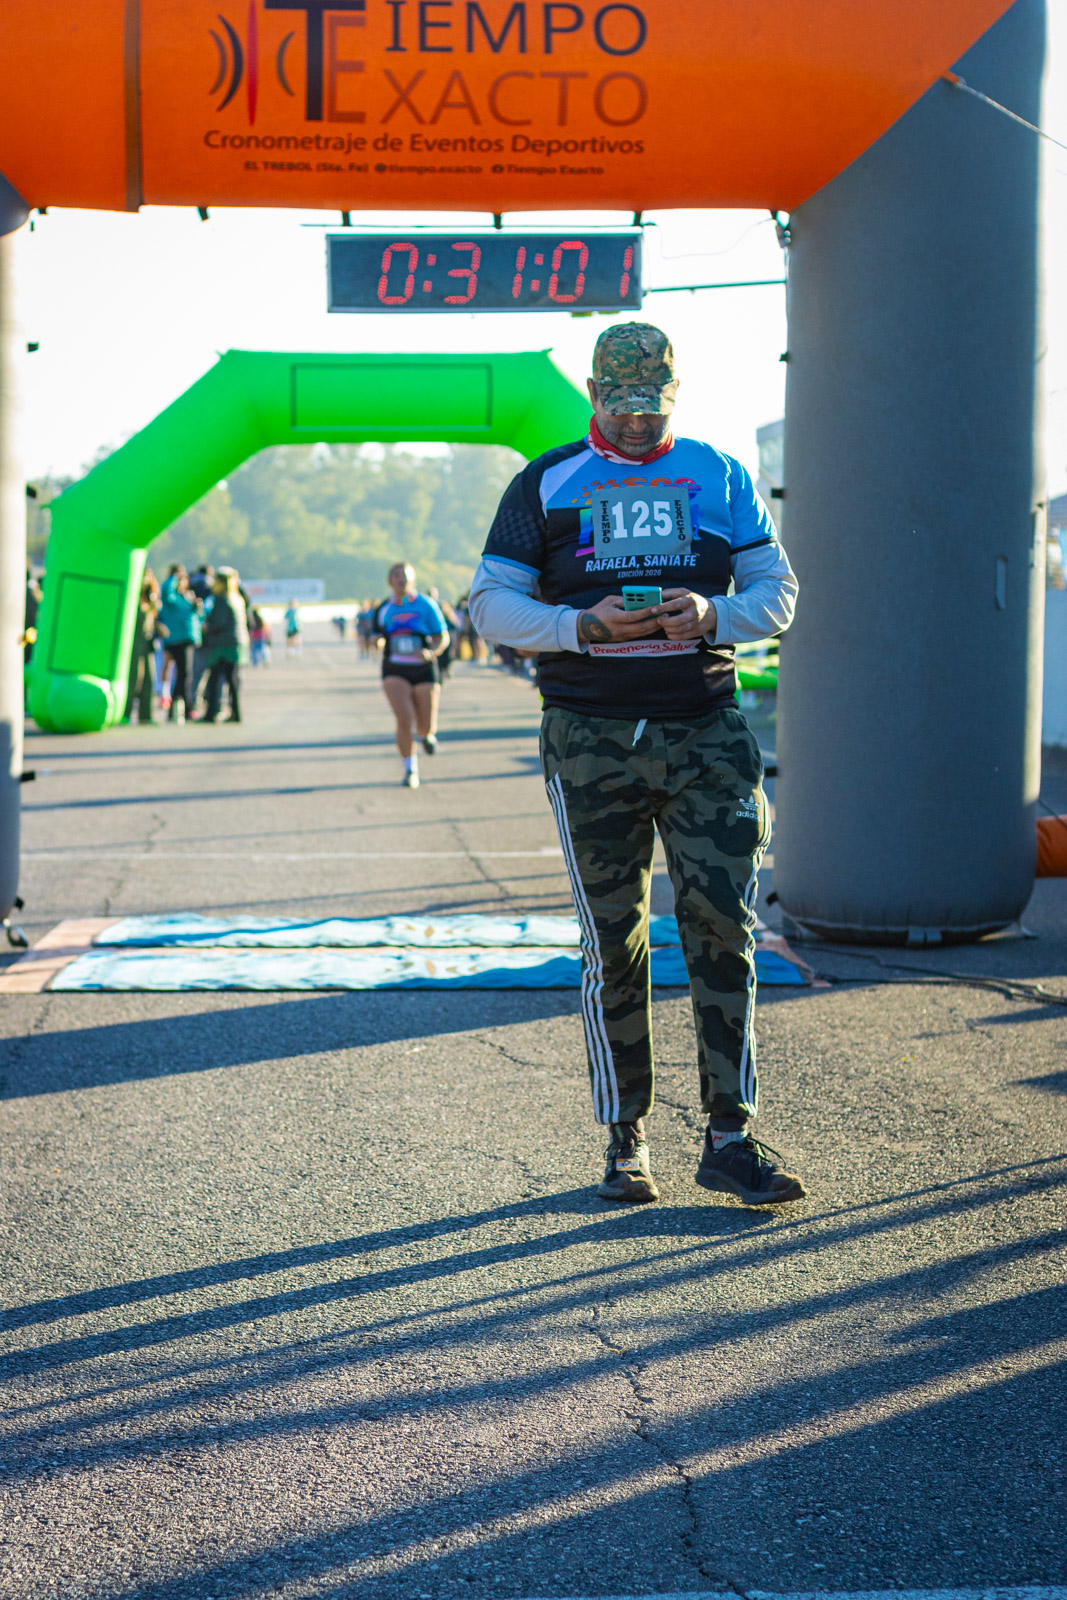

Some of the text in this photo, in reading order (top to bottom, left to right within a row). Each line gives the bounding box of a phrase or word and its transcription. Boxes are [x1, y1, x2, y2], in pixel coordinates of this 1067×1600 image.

[203, 129, 645, 157] Cronometraje de Eventos Deportivos
[600, 500, 611, 544] TIEMPO
[611, 500, 673, 539] 125
[674, 499, 686, 541] EXACTO
[585, 554, 697, 572] RAFAELA, SANTA FE
[644, 568, 662, 577] 2026
